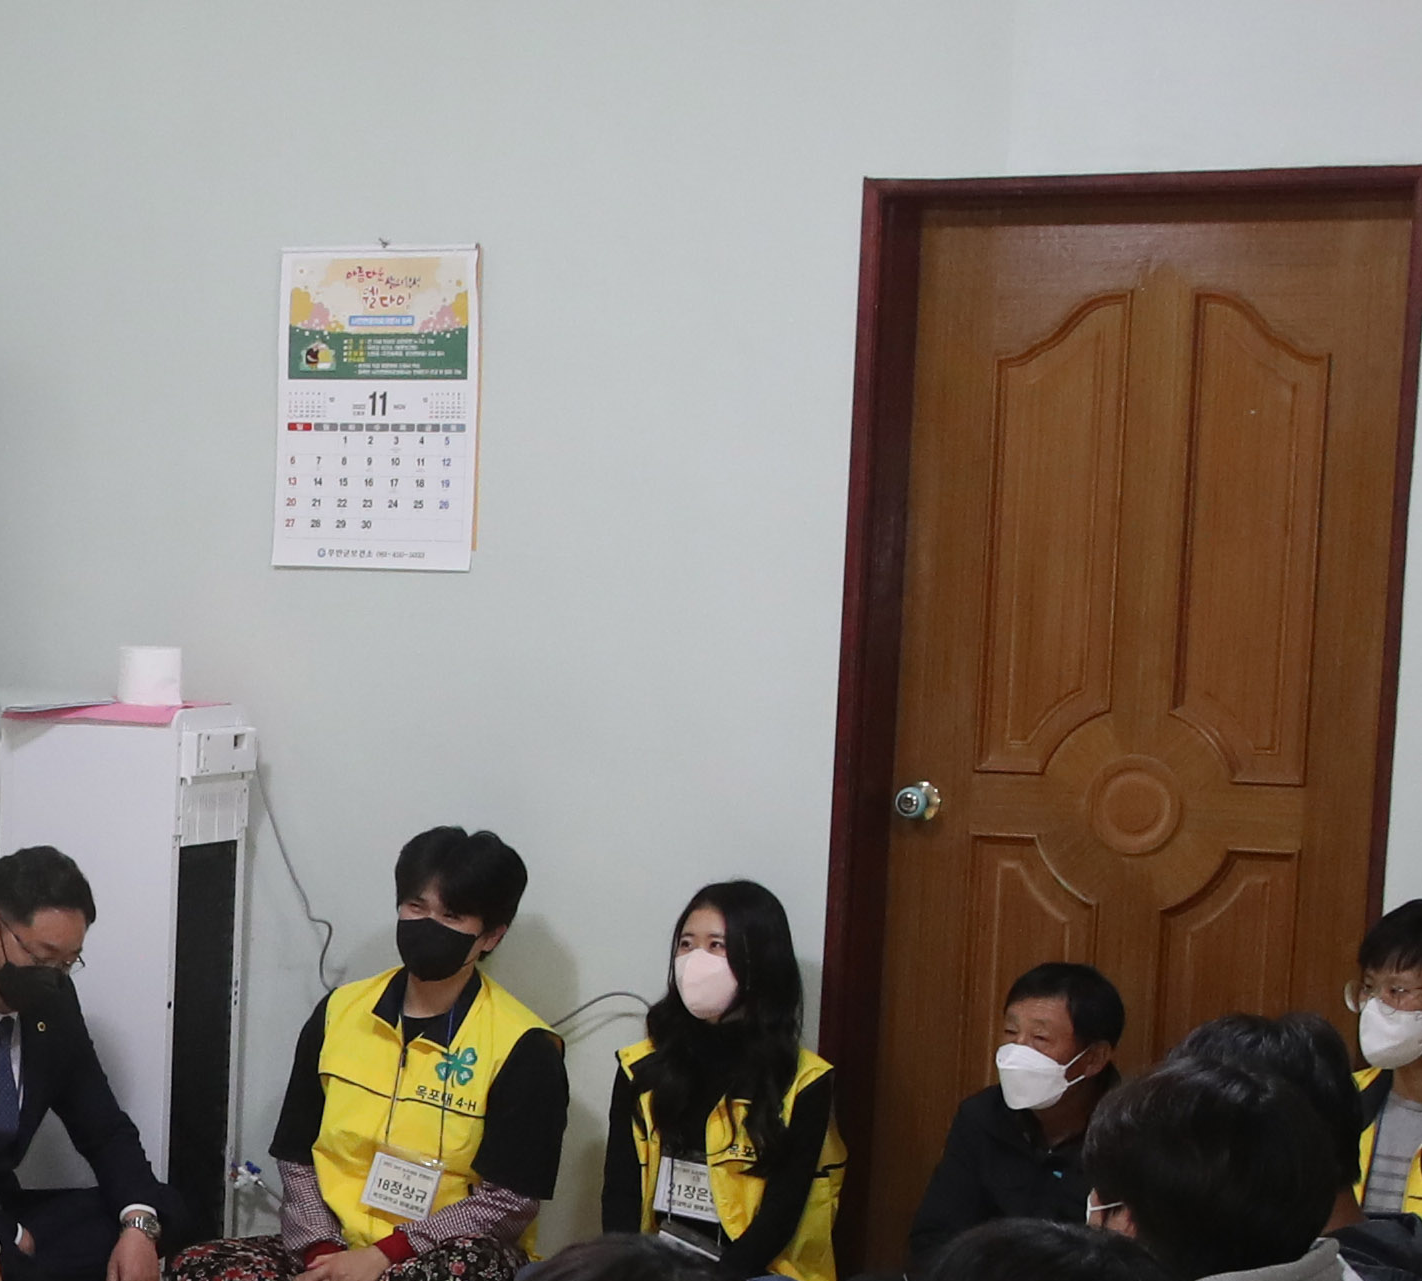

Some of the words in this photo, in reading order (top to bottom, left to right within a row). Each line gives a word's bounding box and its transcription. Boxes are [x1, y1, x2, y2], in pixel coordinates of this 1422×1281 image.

[368, 391, 388, 416] 11
[343, 435, 348, 445] 1
[367, 435, 374, 445] 2
[393, 435, 400, 446] 3
[419, 436, 425, 445] 4
[444, 435, 451, 446] 5
[289, 455, 296, 465] 6
[316, 455, 322, 465] 7
[340, 455, 348, 466] 8
[366, 456, 373, 467] 9
[390, 456, 401, 467] 10
[416, 457, 425, 467] 11
[441, 457, 452, 467] 12
[287, 476, 298, 487] 13
[313, 477, 323, 487] 14
[338, 477, 349, 487] 15
[364, 477, 374, 488] 16
[389, 477, 399, 488] 17
[415, 478, 425, 489] 18
[440, 479, 451, 489] 19
[285, 497, 297, 507] 20
[311, 497, 322, 508] 21
[336, 497, 348, 508] 22
[362, 498, 373, 509] 23
[387, 499, 399, 509] 24
[413, 499, 424, 510] 25
[438, 499, 450, 510] 26
[284, 518, 296, 528] 27
[310, 518, 321, 528] 28
[335, 519, 347, 529] 29
[360, 519, 373, 530] 30
[455, 1097, 477, 1112] 4-H
